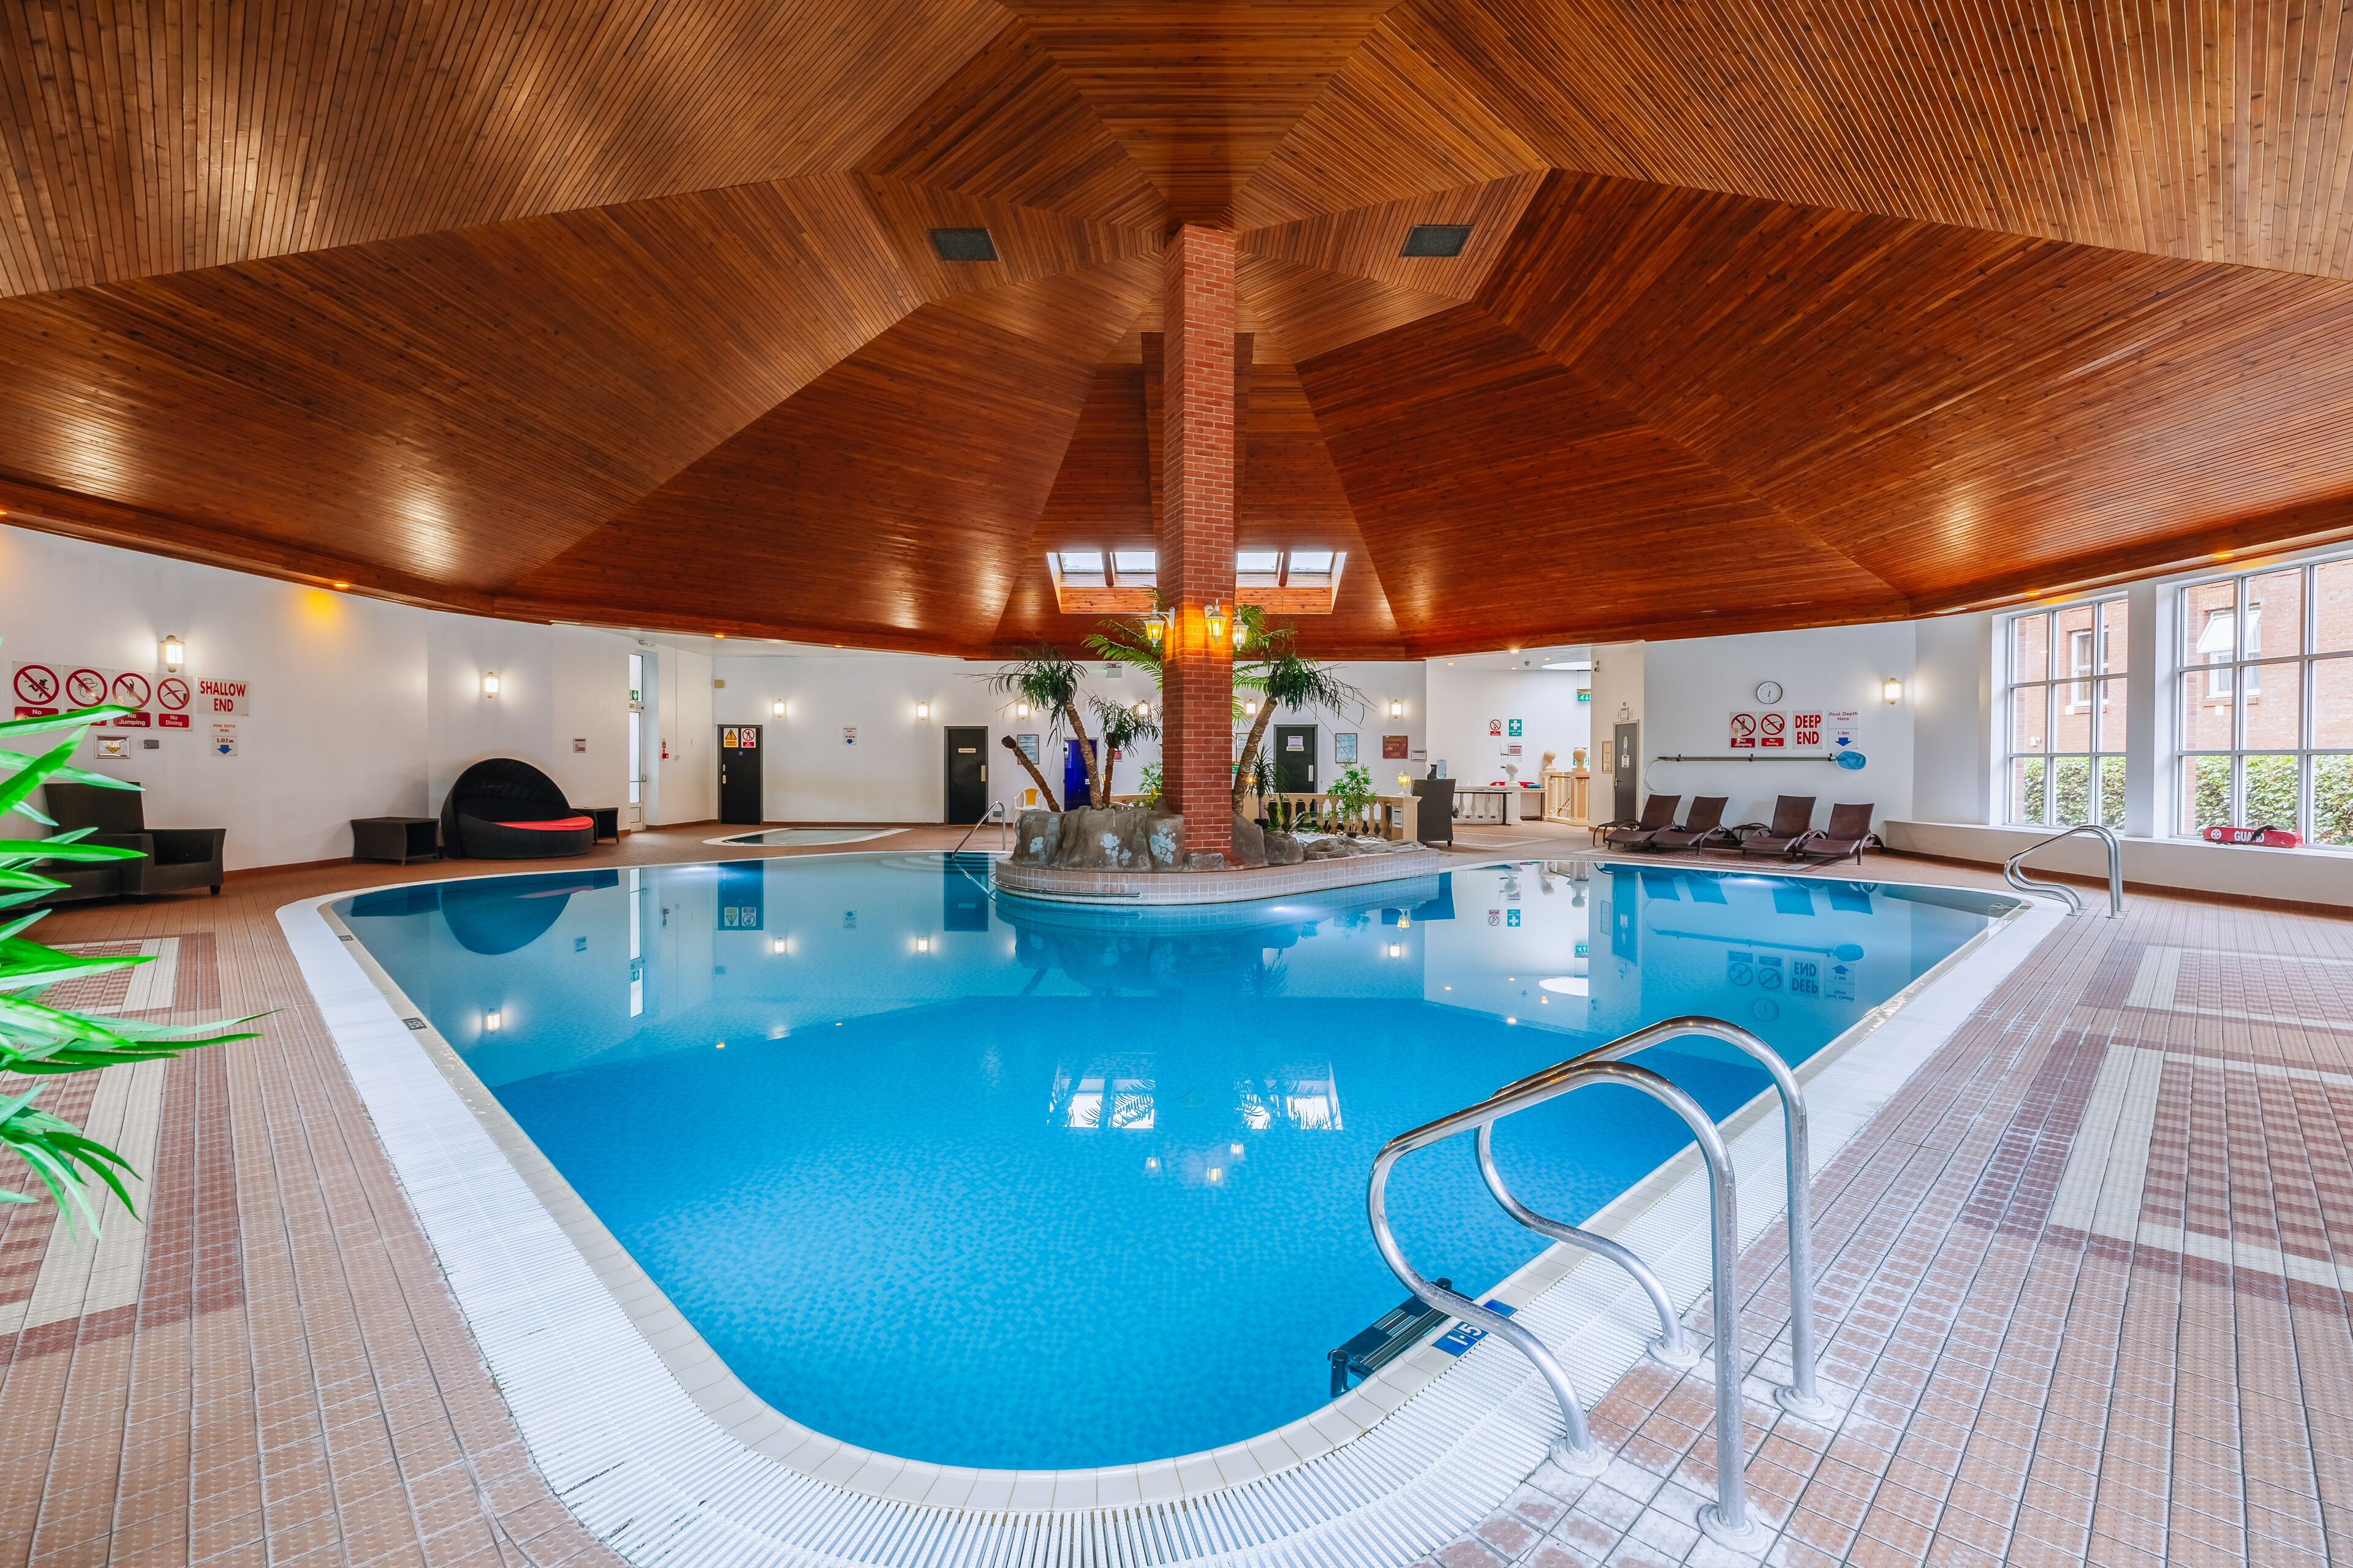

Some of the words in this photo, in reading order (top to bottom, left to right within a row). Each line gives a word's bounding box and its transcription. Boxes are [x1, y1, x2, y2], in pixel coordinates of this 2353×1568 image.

[200, 680, 246, 697] SHALLOW
[214, 698, 233, 712] END
[1795, 714, 1822, 729] DEEP
[1797, 731, 1819, 745] END
[2234, 830, 2265, 843] GUAD
